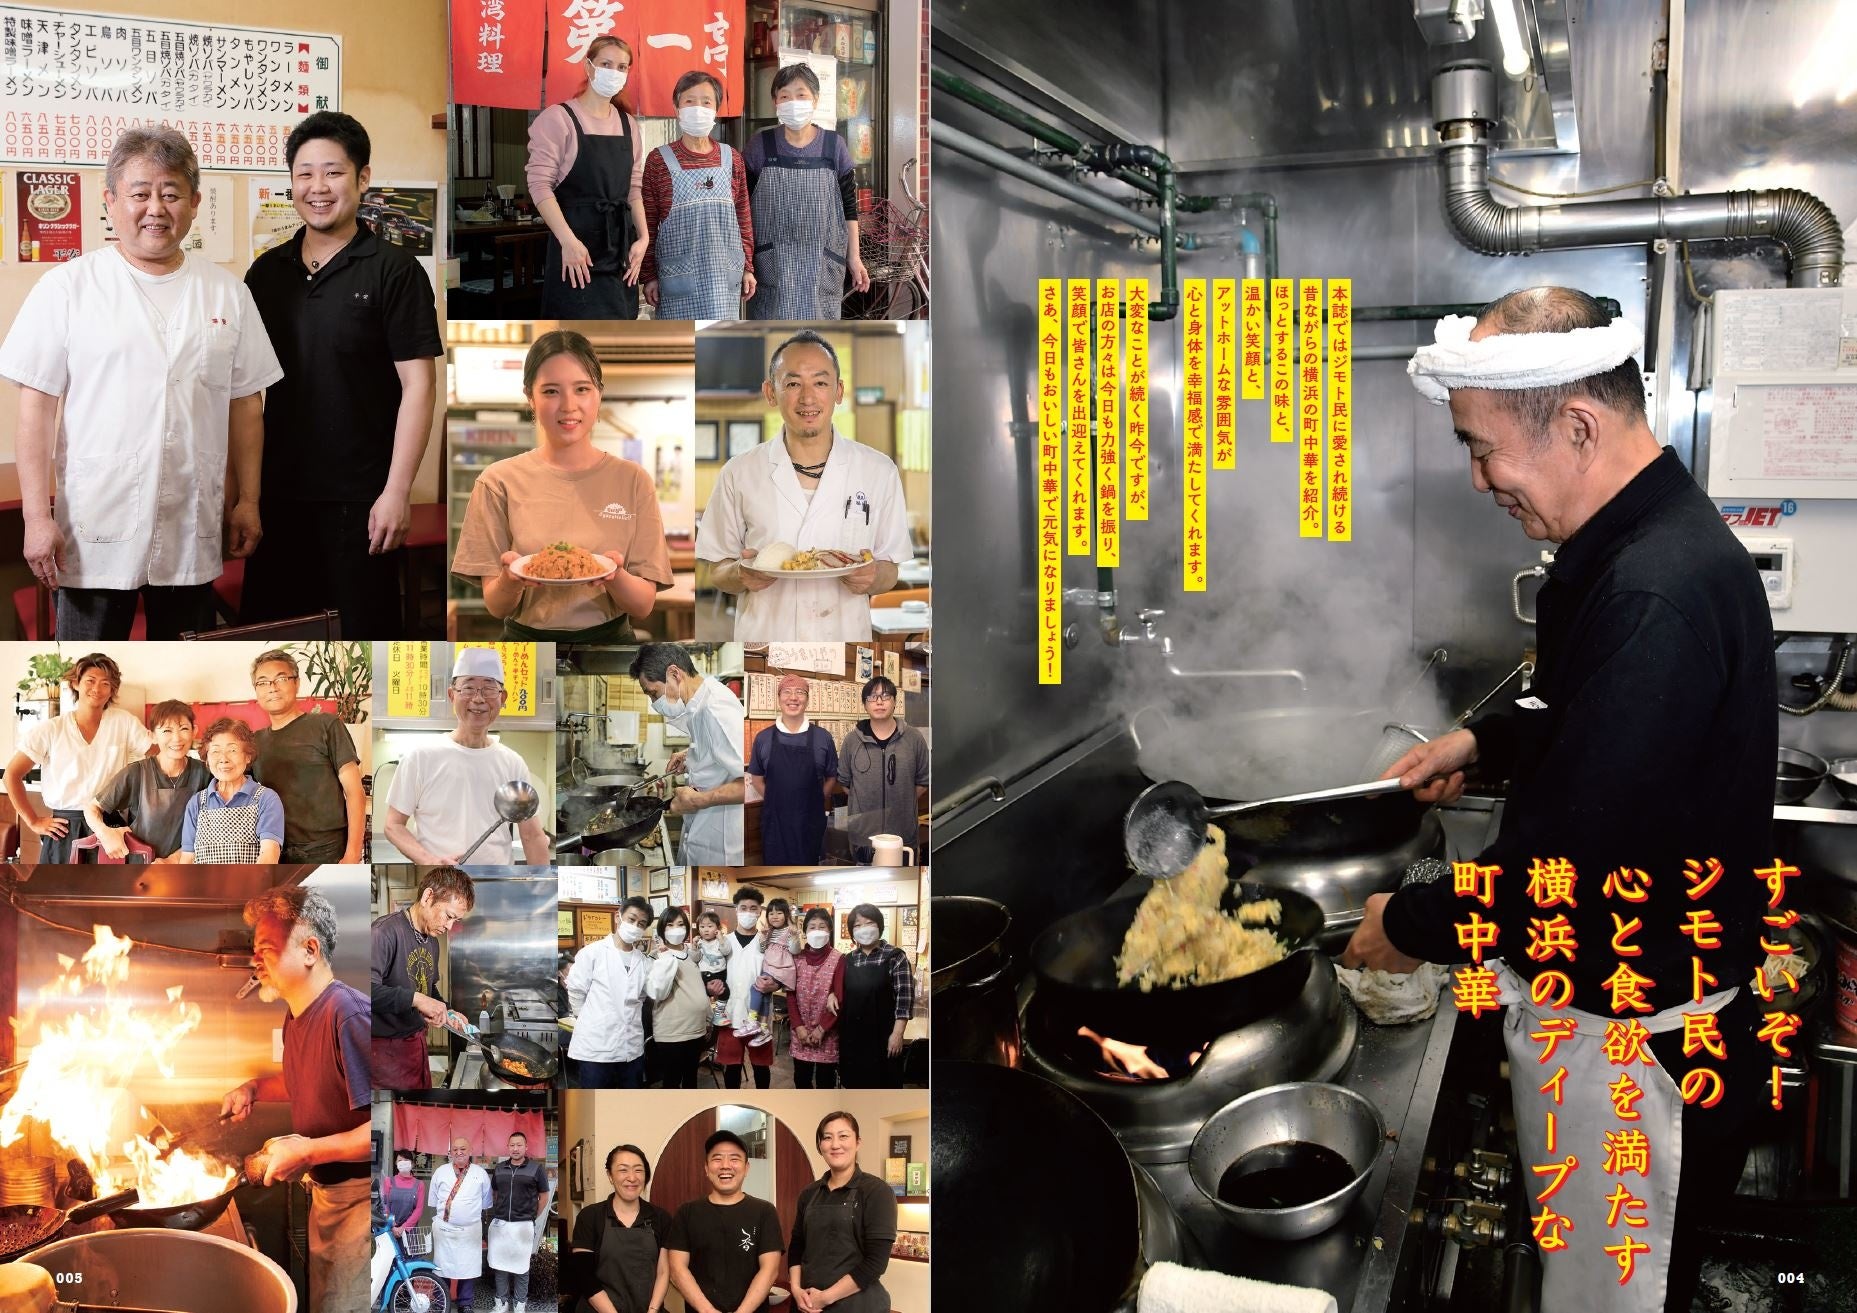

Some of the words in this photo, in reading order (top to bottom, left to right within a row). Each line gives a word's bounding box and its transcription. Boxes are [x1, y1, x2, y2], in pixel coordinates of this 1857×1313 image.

[20, 18, 34, 97] 味噌ラーメン
[37, 19, 49, 97] 天津メン
[216, 36, 227, 109] サンマーメン
[229, 37, 241, 110] タンメン
[243, 39, 254, 111] もやしソバ
[257, 39, 267, 111] ワンタンメン
[270, 41, 281, 112] ワンタン
[283, 41, 294, 112] ラーメン
[23, 172, 76, 185] CLASSIC
[30, 184, 70, 195] LAGER
[465, 428, 517, 444] KIRIN
[1782, 501, 1794, 513] 16
